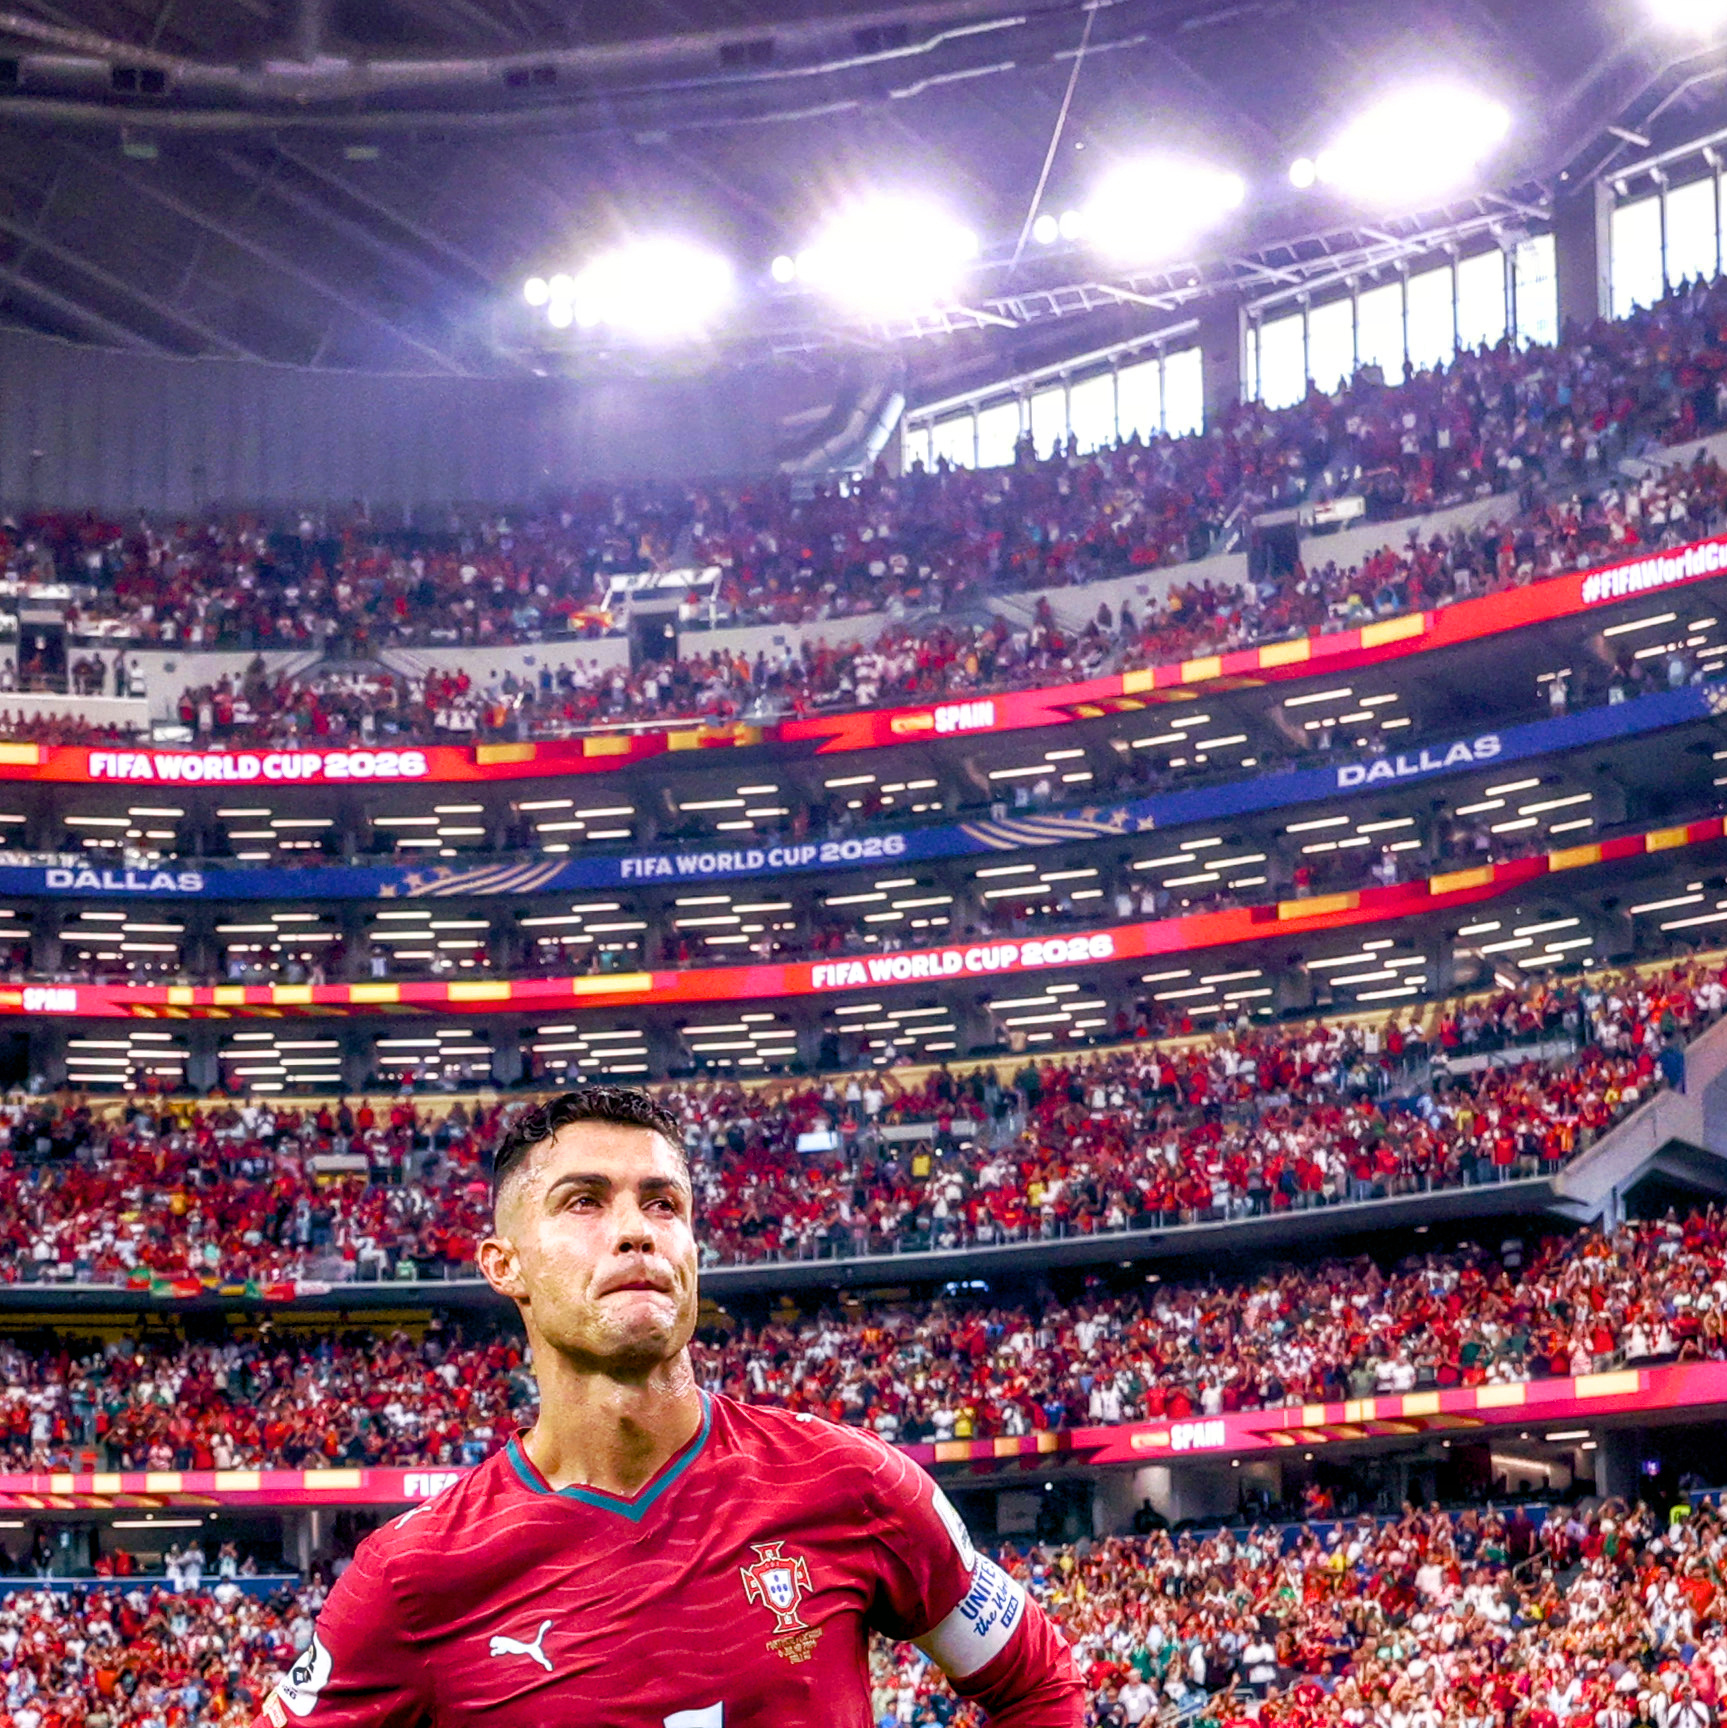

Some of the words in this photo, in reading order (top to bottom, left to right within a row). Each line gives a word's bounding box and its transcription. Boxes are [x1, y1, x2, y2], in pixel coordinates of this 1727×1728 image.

[934, 700, 994, 733] SPAIN
[89, 752, 153, 778] FIFA
[153, 754, 261, 780] WORLD
[262, 754, 322, 779] CUP
[323, 751, 427, 778] 2026
[1337, 734, 1501, 788] DALLAS
[621, 857, 672, 878] FIFA
[675, 852, 764, 875] WORLD
[768, 845, 817, 868] CUP
[819, 835, 907, 862] 2026
[45, 868, 205, 892] DALLAS
[812, 961, 868, 988] FIFA
[868, 951, 962, 981] WORLD
[965, 945, 1019, 971] CUP
[1020, 934, 1114, 966] 2026
[1170, 1420, 1225, 1451] SPAIN
[973, 1609, 998, 1637] the
